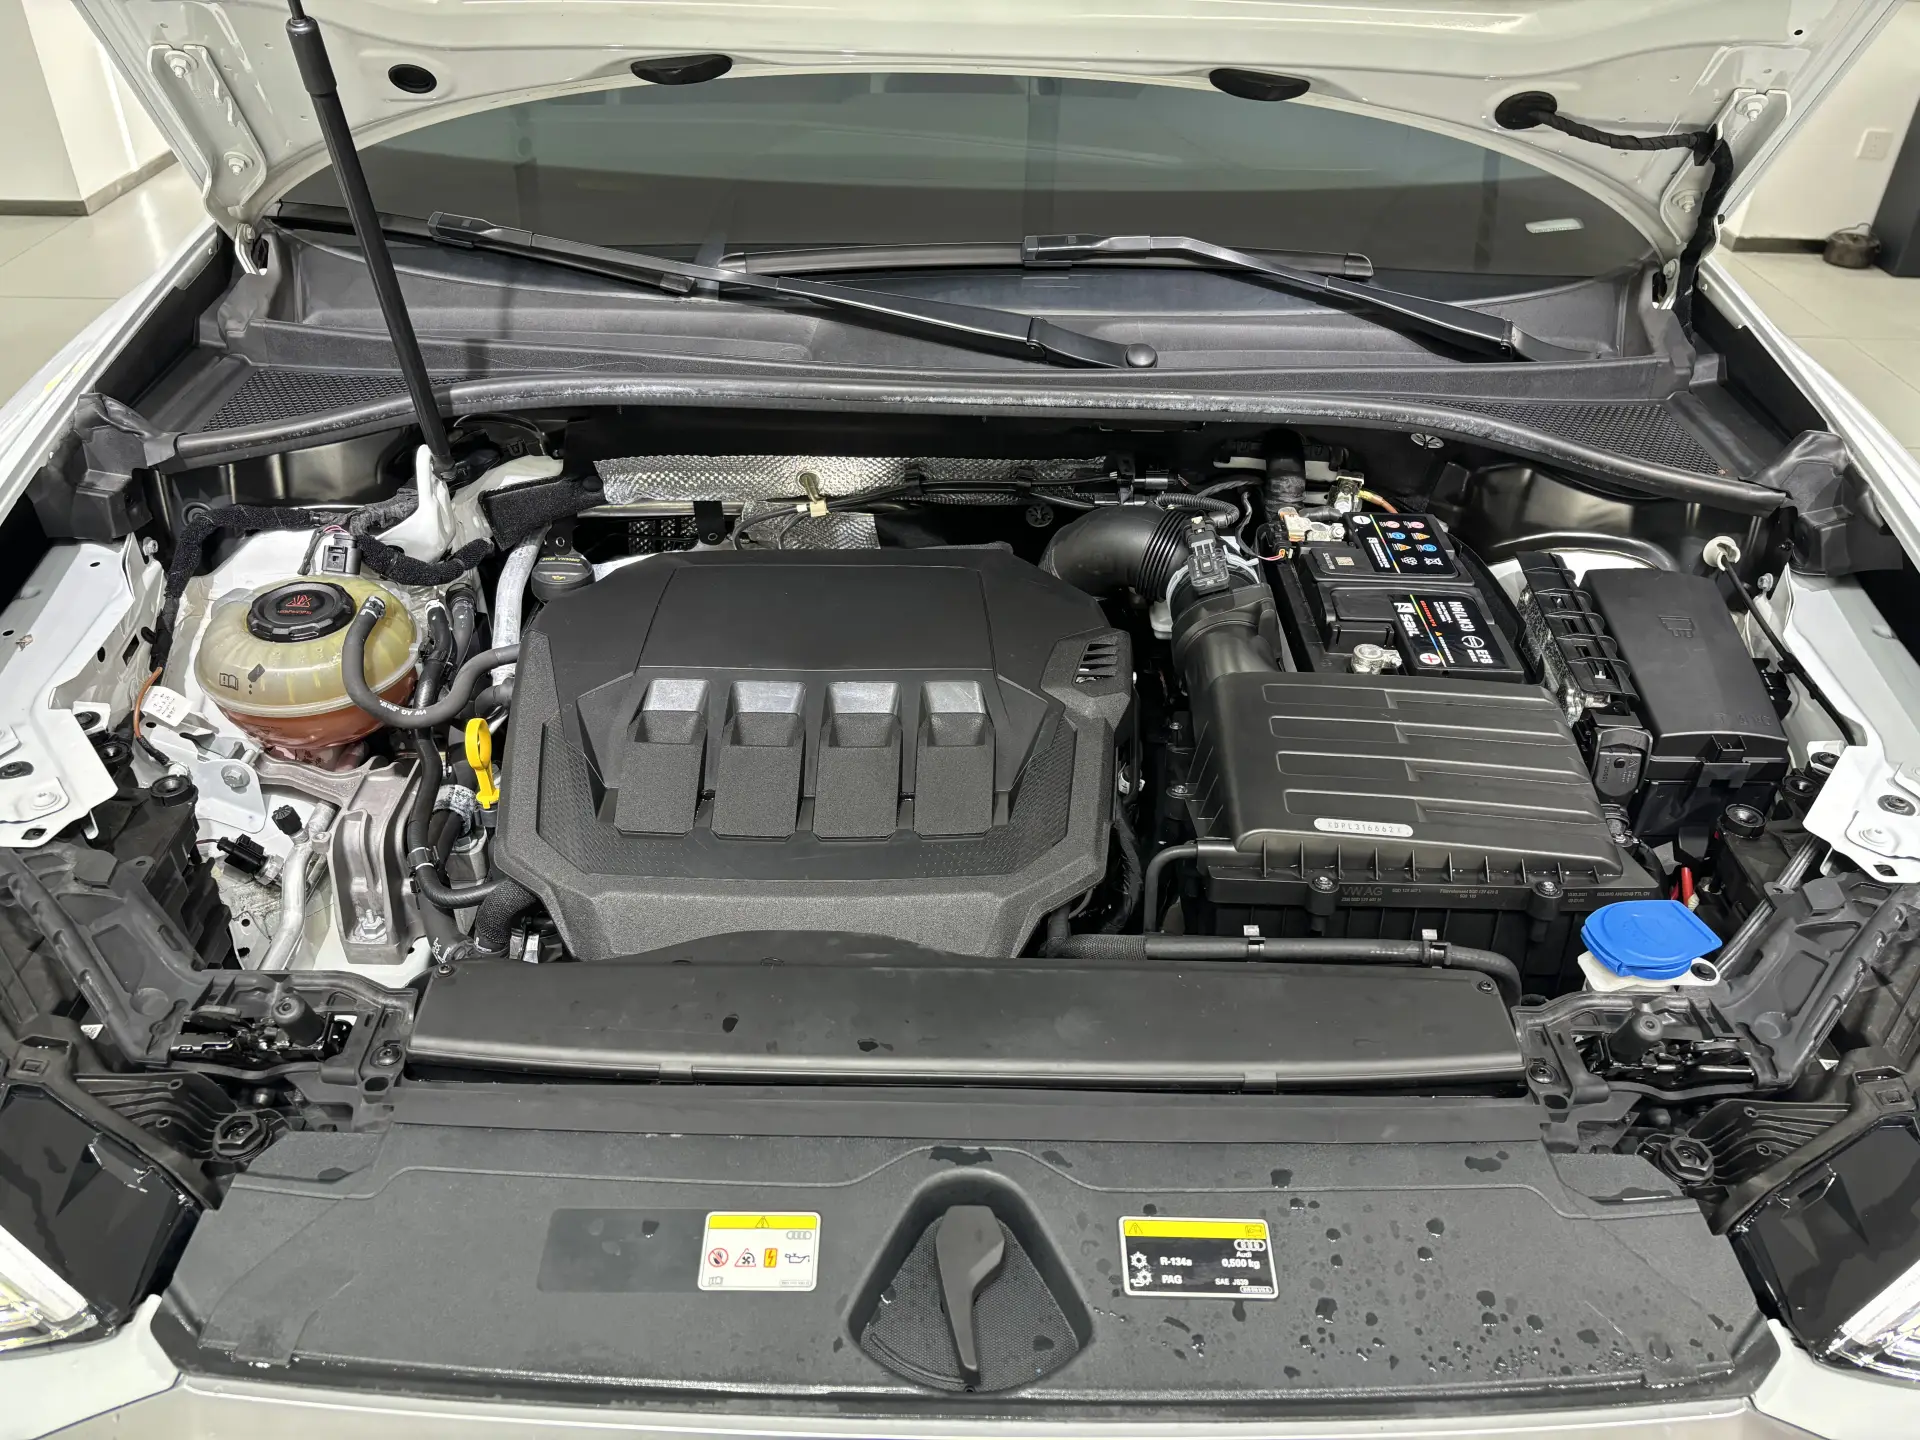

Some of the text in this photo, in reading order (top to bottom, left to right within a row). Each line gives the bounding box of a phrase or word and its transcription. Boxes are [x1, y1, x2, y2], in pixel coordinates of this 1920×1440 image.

[1342, 886, 1363, 896] VW
[1364, 886, 1383, 896] AG
[1160, 1256, 1193, 1266] R-134a
[1248, 1258, 1261, 1270] kg
[1161, 1274, 1183, 1284] PAG
[1214, 1277, 1230, 1286] SAE
